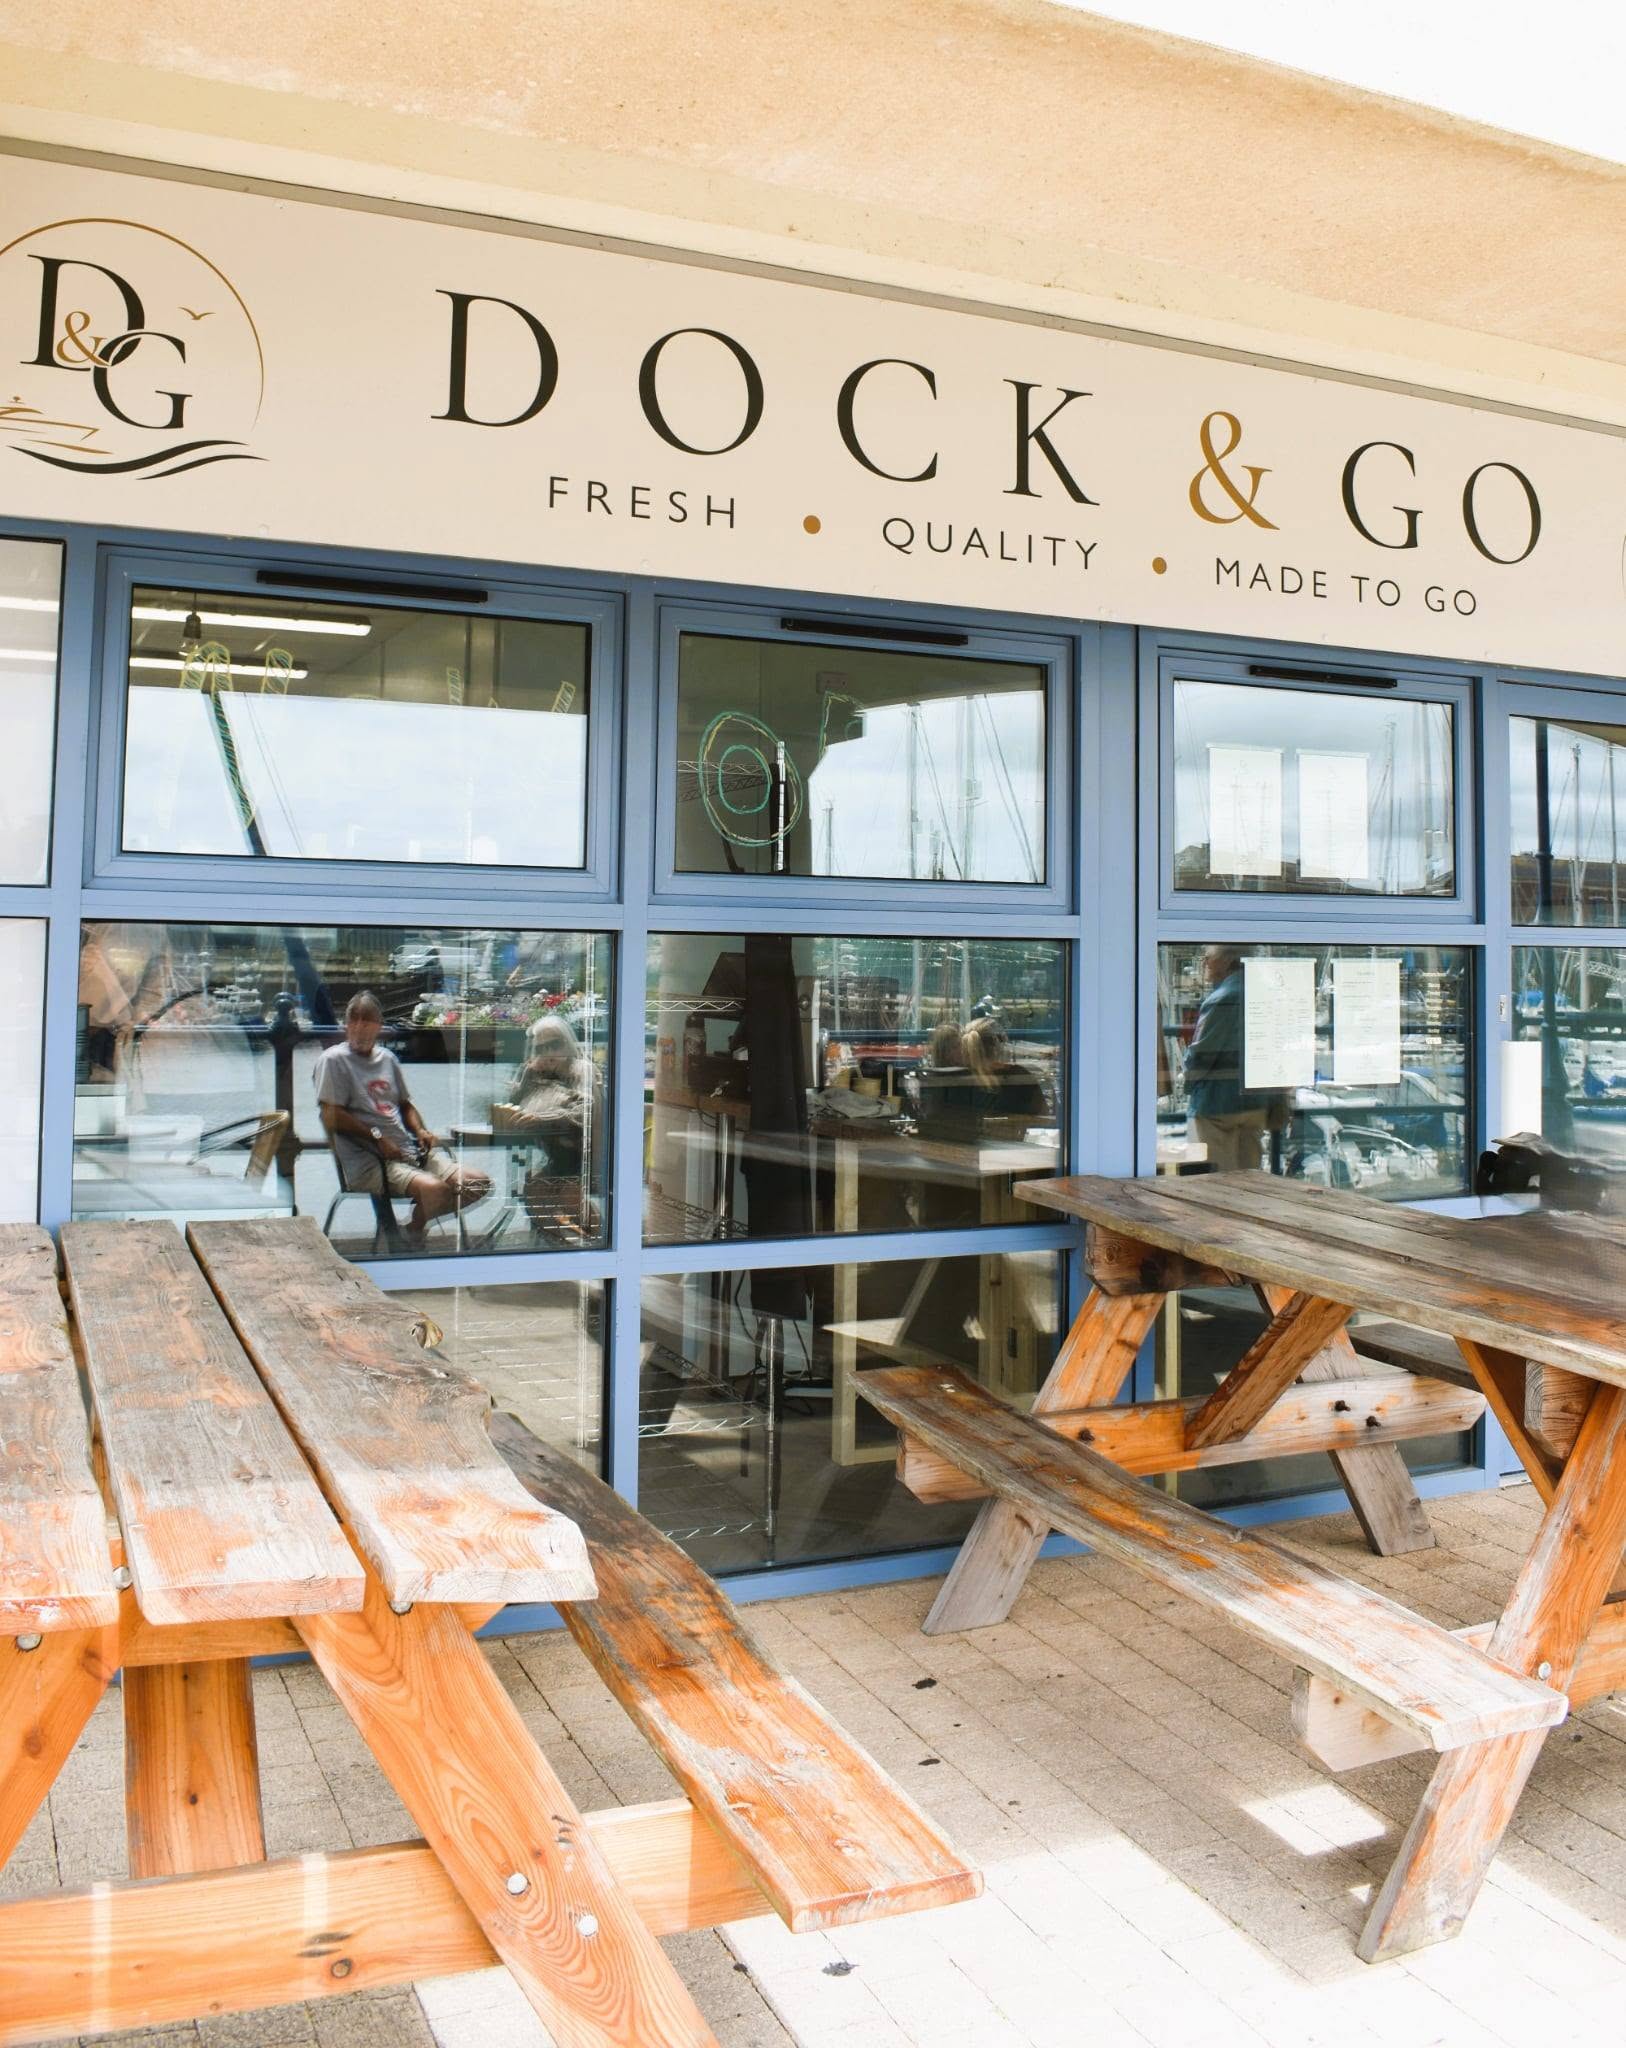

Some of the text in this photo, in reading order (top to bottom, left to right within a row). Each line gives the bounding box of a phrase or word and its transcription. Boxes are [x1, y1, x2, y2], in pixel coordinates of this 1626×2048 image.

[429, 287, 1544, 566] DOCK & GO
[547, 474, 1479, 618] FRESH QUALITY MADE TO GO
